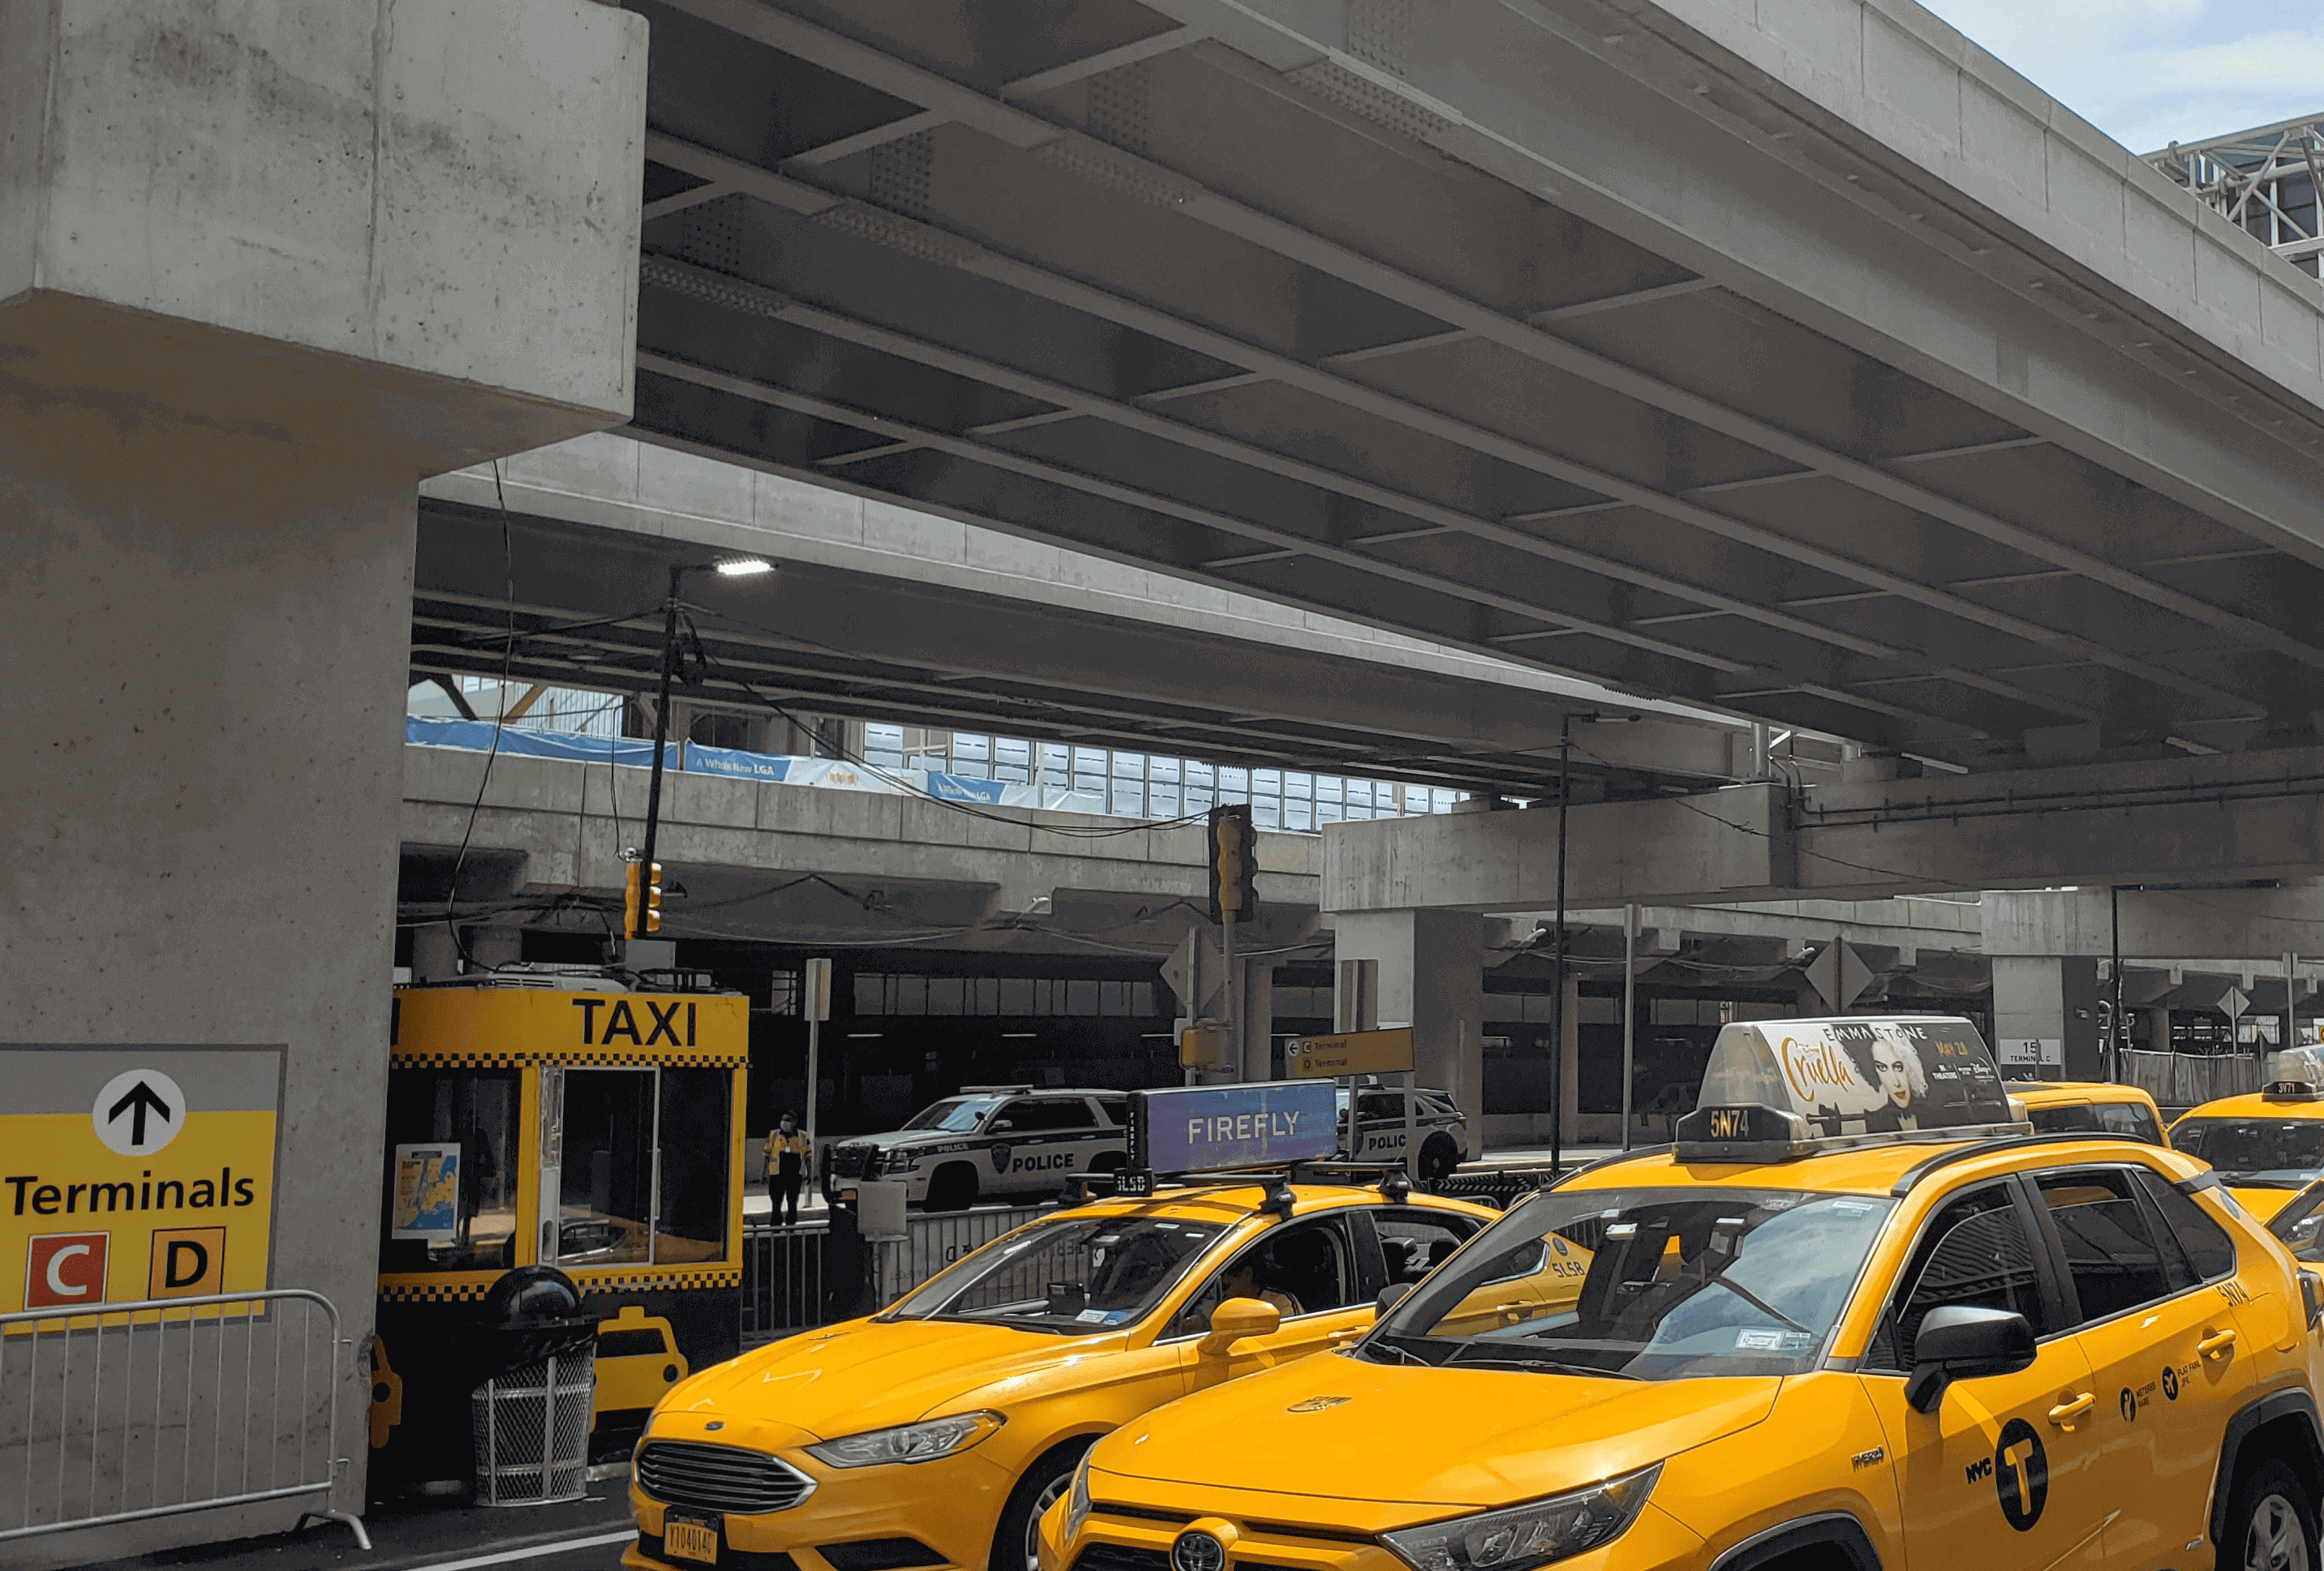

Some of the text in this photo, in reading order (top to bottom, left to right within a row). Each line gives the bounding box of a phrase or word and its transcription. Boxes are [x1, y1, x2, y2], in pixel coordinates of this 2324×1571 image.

[754, 763, 775, 775] LGA
[571, 998, 697, 1047] TAXI
[1823, 1025, 1928, 1041] EMMA STONE
[1315, 1039, 1347, 1051] Terminal
[1315, 1057, 1348, 1068] Terminal
[1781, 1037, 1855, 1102] Cruella
[1188, 1110, 1299, 1145] FIREFLY
[1711, 1110, 1750, 1138] 5N74
[936, 1143, 969, 1153] POLICE
[1368, 1134, 1407, 1151] POLIC
[1012, 1152, 1075, 1174] POLICE
[4, 1166, 255, 1217] Terminals
[46, 1243, 91, 1296] C
[164, 1240, 208, 1289] D
[1965, 1457, 1992, 1484] NYC
[2004, 1438, 2034, 1516] T
